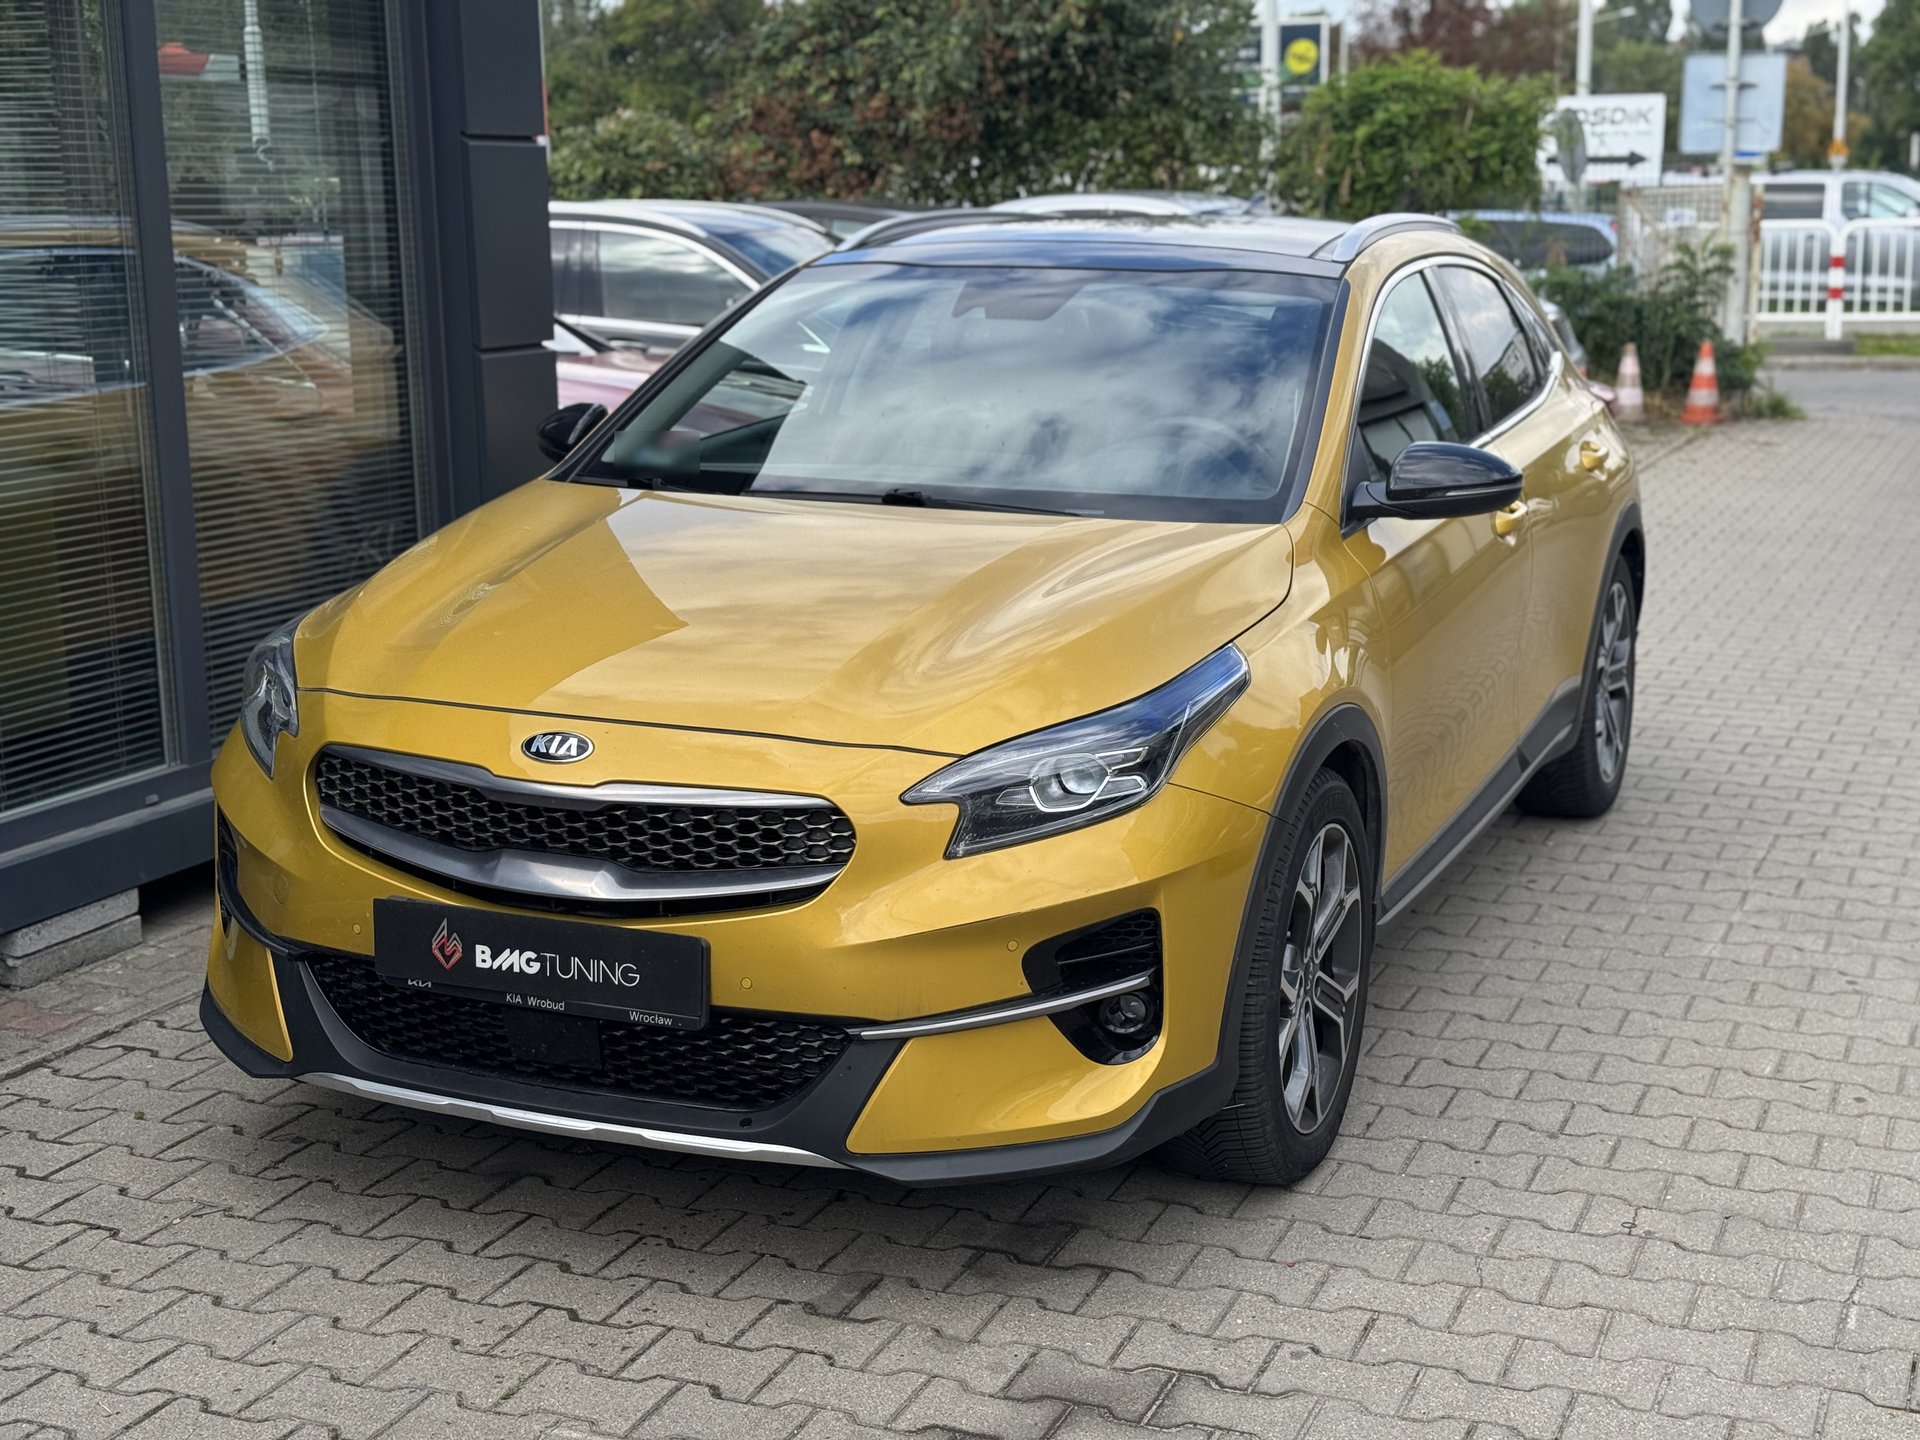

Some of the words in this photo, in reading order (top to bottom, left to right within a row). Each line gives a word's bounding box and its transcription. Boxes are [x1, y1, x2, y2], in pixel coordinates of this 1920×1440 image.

[530, 734, 578, 757] KIA
[506, 993, 522, 1004] KIA
[527, 996, 565, 1011] Wrobud
[629, 1010, 673, 1026] Wrocław
